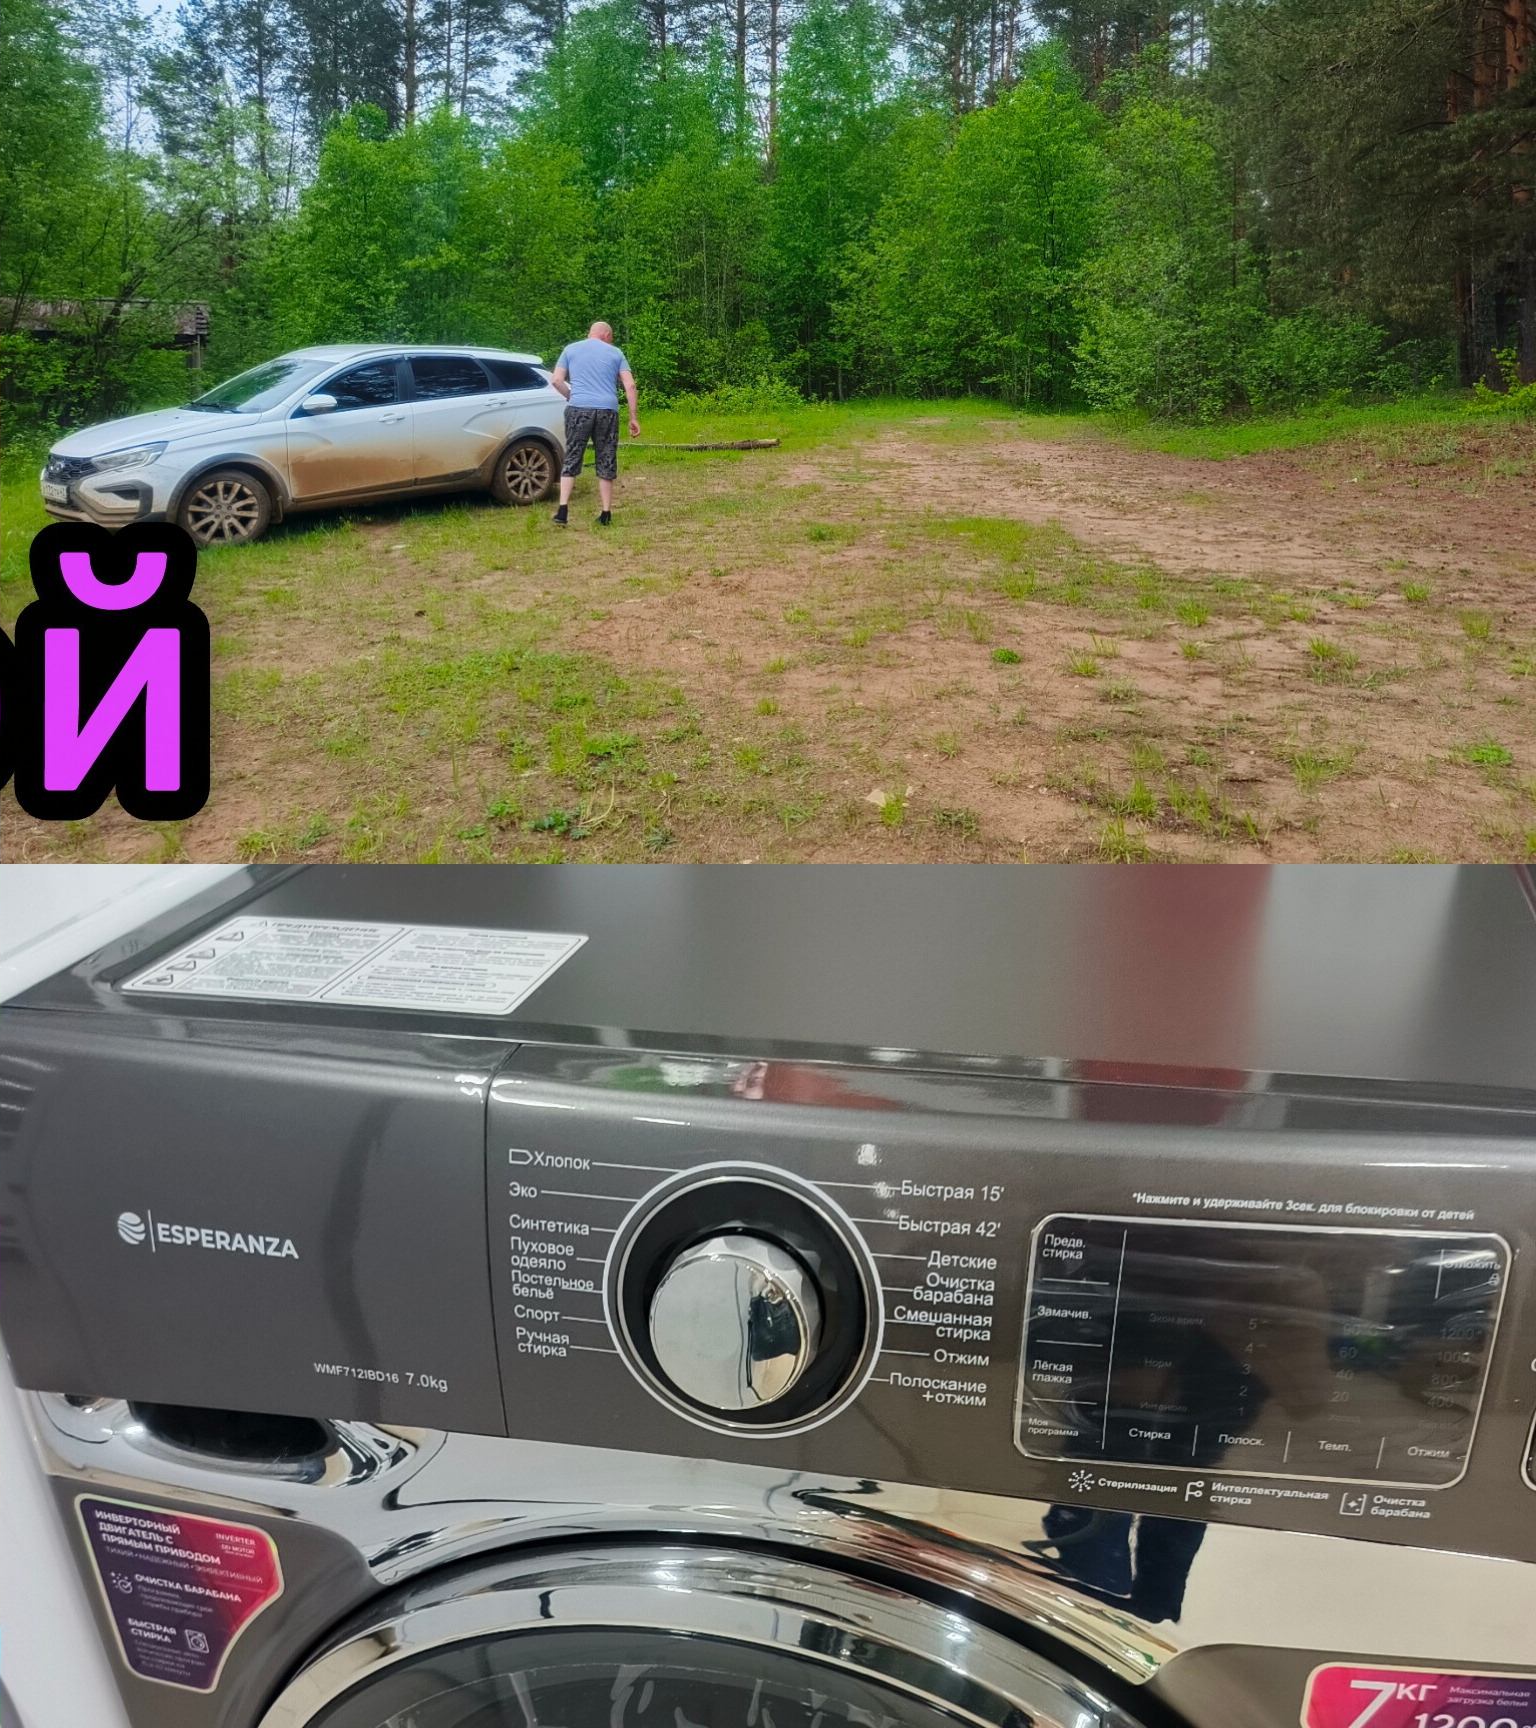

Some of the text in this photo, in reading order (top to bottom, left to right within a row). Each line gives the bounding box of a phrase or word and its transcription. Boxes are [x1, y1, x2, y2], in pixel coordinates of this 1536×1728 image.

[533, 1151, 590, 1170] Хлопок
[509, 1182, 537, 1198] Эко
[901, 1180, 1005, 1201] Быстрая 15'
[1193, 1196, 1201, 1206] и
[1203, 1196, 1282, 1210] удерживайте
[1318, 1203, 1342, 1214] для
[1345, 1202, 1418, 1218] блокировки
[1421, 1209, 1436, 1219] от
[1437, 1209, 1475, 1220] детей
[509, 1214, 589, 1235] Синтетика
[898, 1215, 1001, 1237] Быстрая 42'
[157, 1222, 299, 1259] ESPERANZA
[511, 1237, 574, 1256] Пуховое
[1044, 1234, 1086, 1248] Предв.
[927, 1251, 997, 1269] Детские
[1042, 1248, 1083, 1260] стирка
[511, 1256, 566, 1271] одеяло
[511, 1270, 594, 1291] Постельное
[926, 1272, 995, 1292] Очистка
[512, 1284, 554, 1300] бельё
[913, 1286, 994, 1306] барабана
[514, 1305, 560, 1324] Спорт
[894, 1305, 992, 1327] Смешанная
[1037, 1305, 1092, 1320] Замачив.
[516, 1327, 569, 1345] Ручная
[936, 1326, 991, 1342] стирка
[518, 1342, 567, 1358] стирка
[933, 1348, 990, 1366] Отжим
[1033, 1359, 1073, 1373] Лёгкая
[405, 1372, 448, 1393] 7.0kg
[889, 1372, 987, 1393] Полоскание
[1032, 1373, 1072, 1385] глажка
[922, 1391, 986, 1407] +отжим
[1028, 1417, 1049, 1427] Моя
[1028, 1426, 1079, 1437] программа
[1128, 1428, 1171, 1440] Стирка
[1218, 1434, 1265, 1446] Полоск.
[1318, 1440, 1352, 1452] Темп.
[1407, 1446, 1450, 1459] Отжим
[1098, 1478, 1177, 1494] Стерилизация
[1211, 1482, 1330, 1501] Интеллектуальная
[1210, 1494, 1252, 1506] стирка
[1373, 1495, 1426, 1507] Очистка
[1370, 1506, 1431, 1520] барабана
[95, 1509, 181, 1535] ИНВЕРТОРНЫЙ
[99, 1521, 174, 1545] ДВИГАТЕЛЬ С
[215, 1533, 256, 1546] INVERTER
[102, 1533, 221, 1565] ПРЯМЫМ ПРИВОДОМ
[135, 1573, 242, 1603] ОЧИСТКА БАРАБАНА
[127, 1618, 177, 1635] БЫСТРАЯ
[130, 1627, 172, 1643] СТИРКА
[1449, 1686, 1530, 1698] Максимальная
[1348, 1679, 1397, 1728] 7
[1447, 1696, 1494, 1706] загрузка
